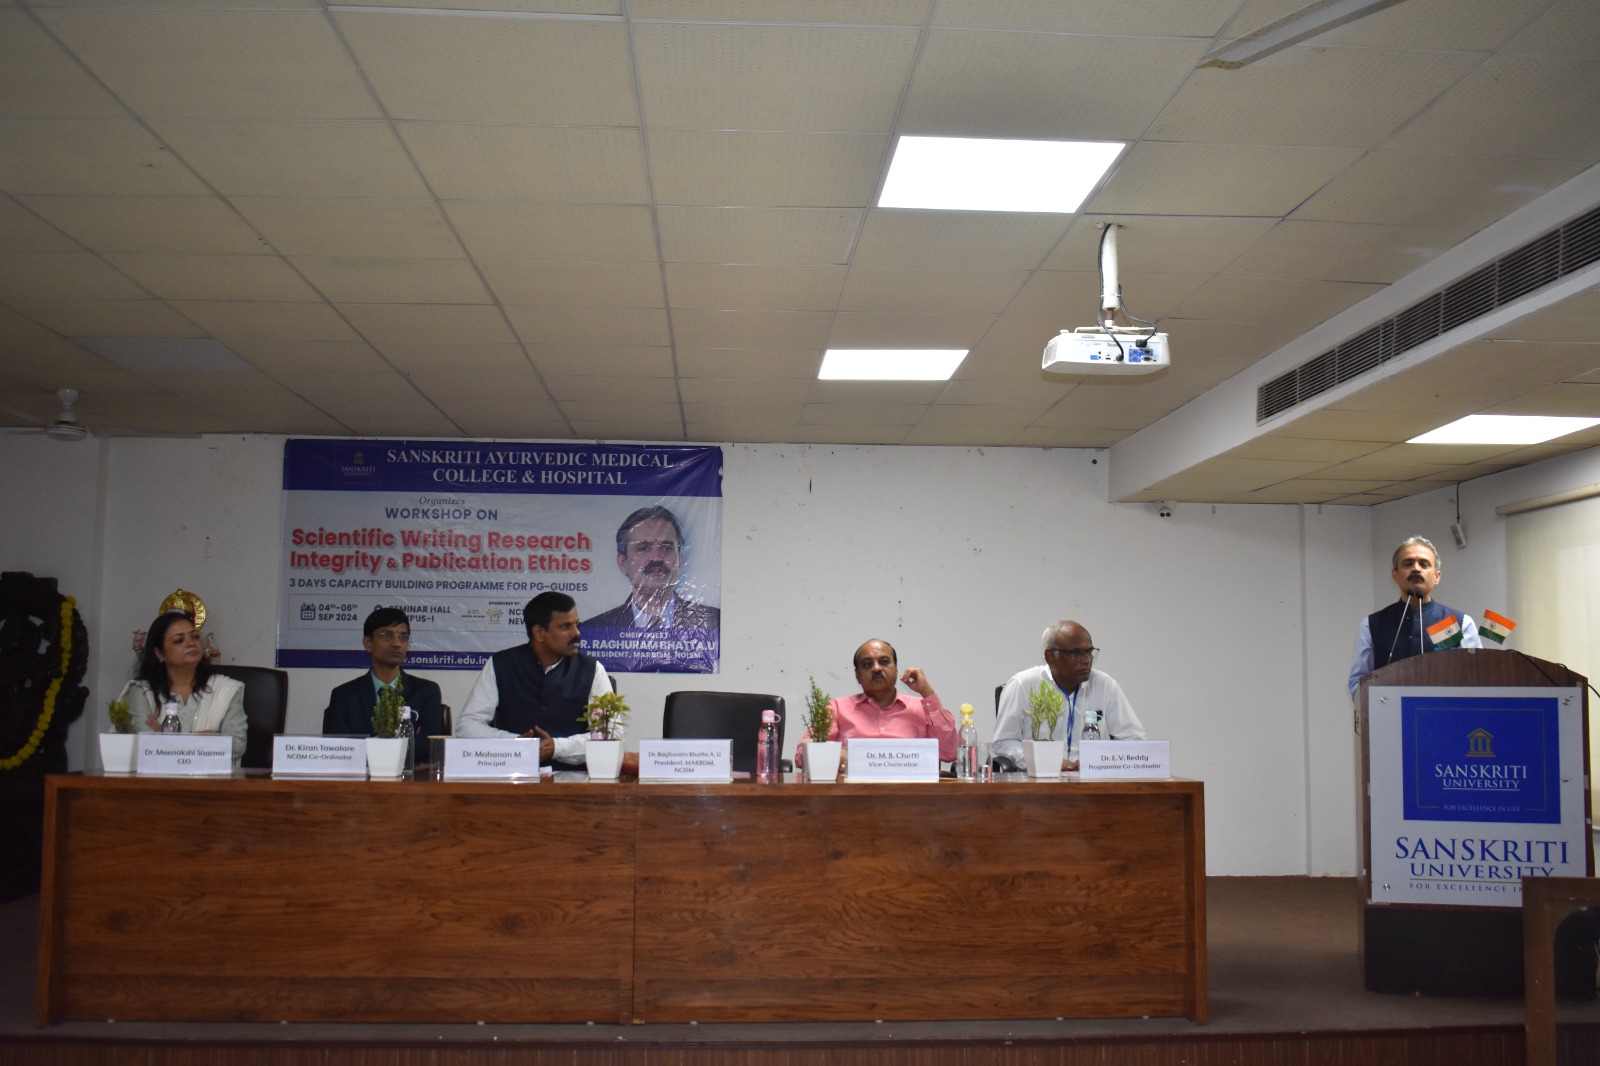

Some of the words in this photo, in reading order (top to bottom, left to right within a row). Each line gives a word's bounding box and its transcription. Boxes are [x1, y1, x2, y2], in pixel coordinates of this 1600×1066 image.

[388, 450, 480, 464] SANSKRITI
[485, 451, 587, 466] AYURVEDIC
[592, 453, 674, 467] MEDICAL
[433, 469, 517, 483] COLLEGE
[522, 470, 535, 483] &
[541, 471, 628, 485] HOSPITAL
[419, 496, 465, 507] Organizes
[385, 508, 472, 519] WORKSHOP
[476, 509, 498, 520] ON
[292, 527, 395, 546] Scientific
[400, 529, 482, 553] Writing
[488, 531, 590, 550] Research
[290, 551, 382, 573] Integrity
[386, 556, 397, 569] &
[402, 552, 522, 571] Publication
[528, 554, 591, 572] Ethics
[290, 578, 296, 587] 3
[298, 579, 327, 588] DAYS
[329, 579, 383, 589] CAPACITY
[385, 580, 434, 589] BUILDING
[436, 580, 505, 591] PROGRAMME
[507, 582, 528, 591] FOR
[530, 582, 588, 592] PG-GUIDES
[430, 606, 451, 614] HALL
[318, 613, 335, 621] SEP
[336, 613, 358, 621] 2024
[477, 760, 506, 768] Principal
[1434, 763, 1527, 779] SANSKRITI
[1442, 778, 1520, 788] UNIVERSITY
[1395, 836, 1569, 864] SANSKRITI
[1409, 882, 1431, 890] FOR
[1436, 883, 1507, 893] EXCELLENCE
